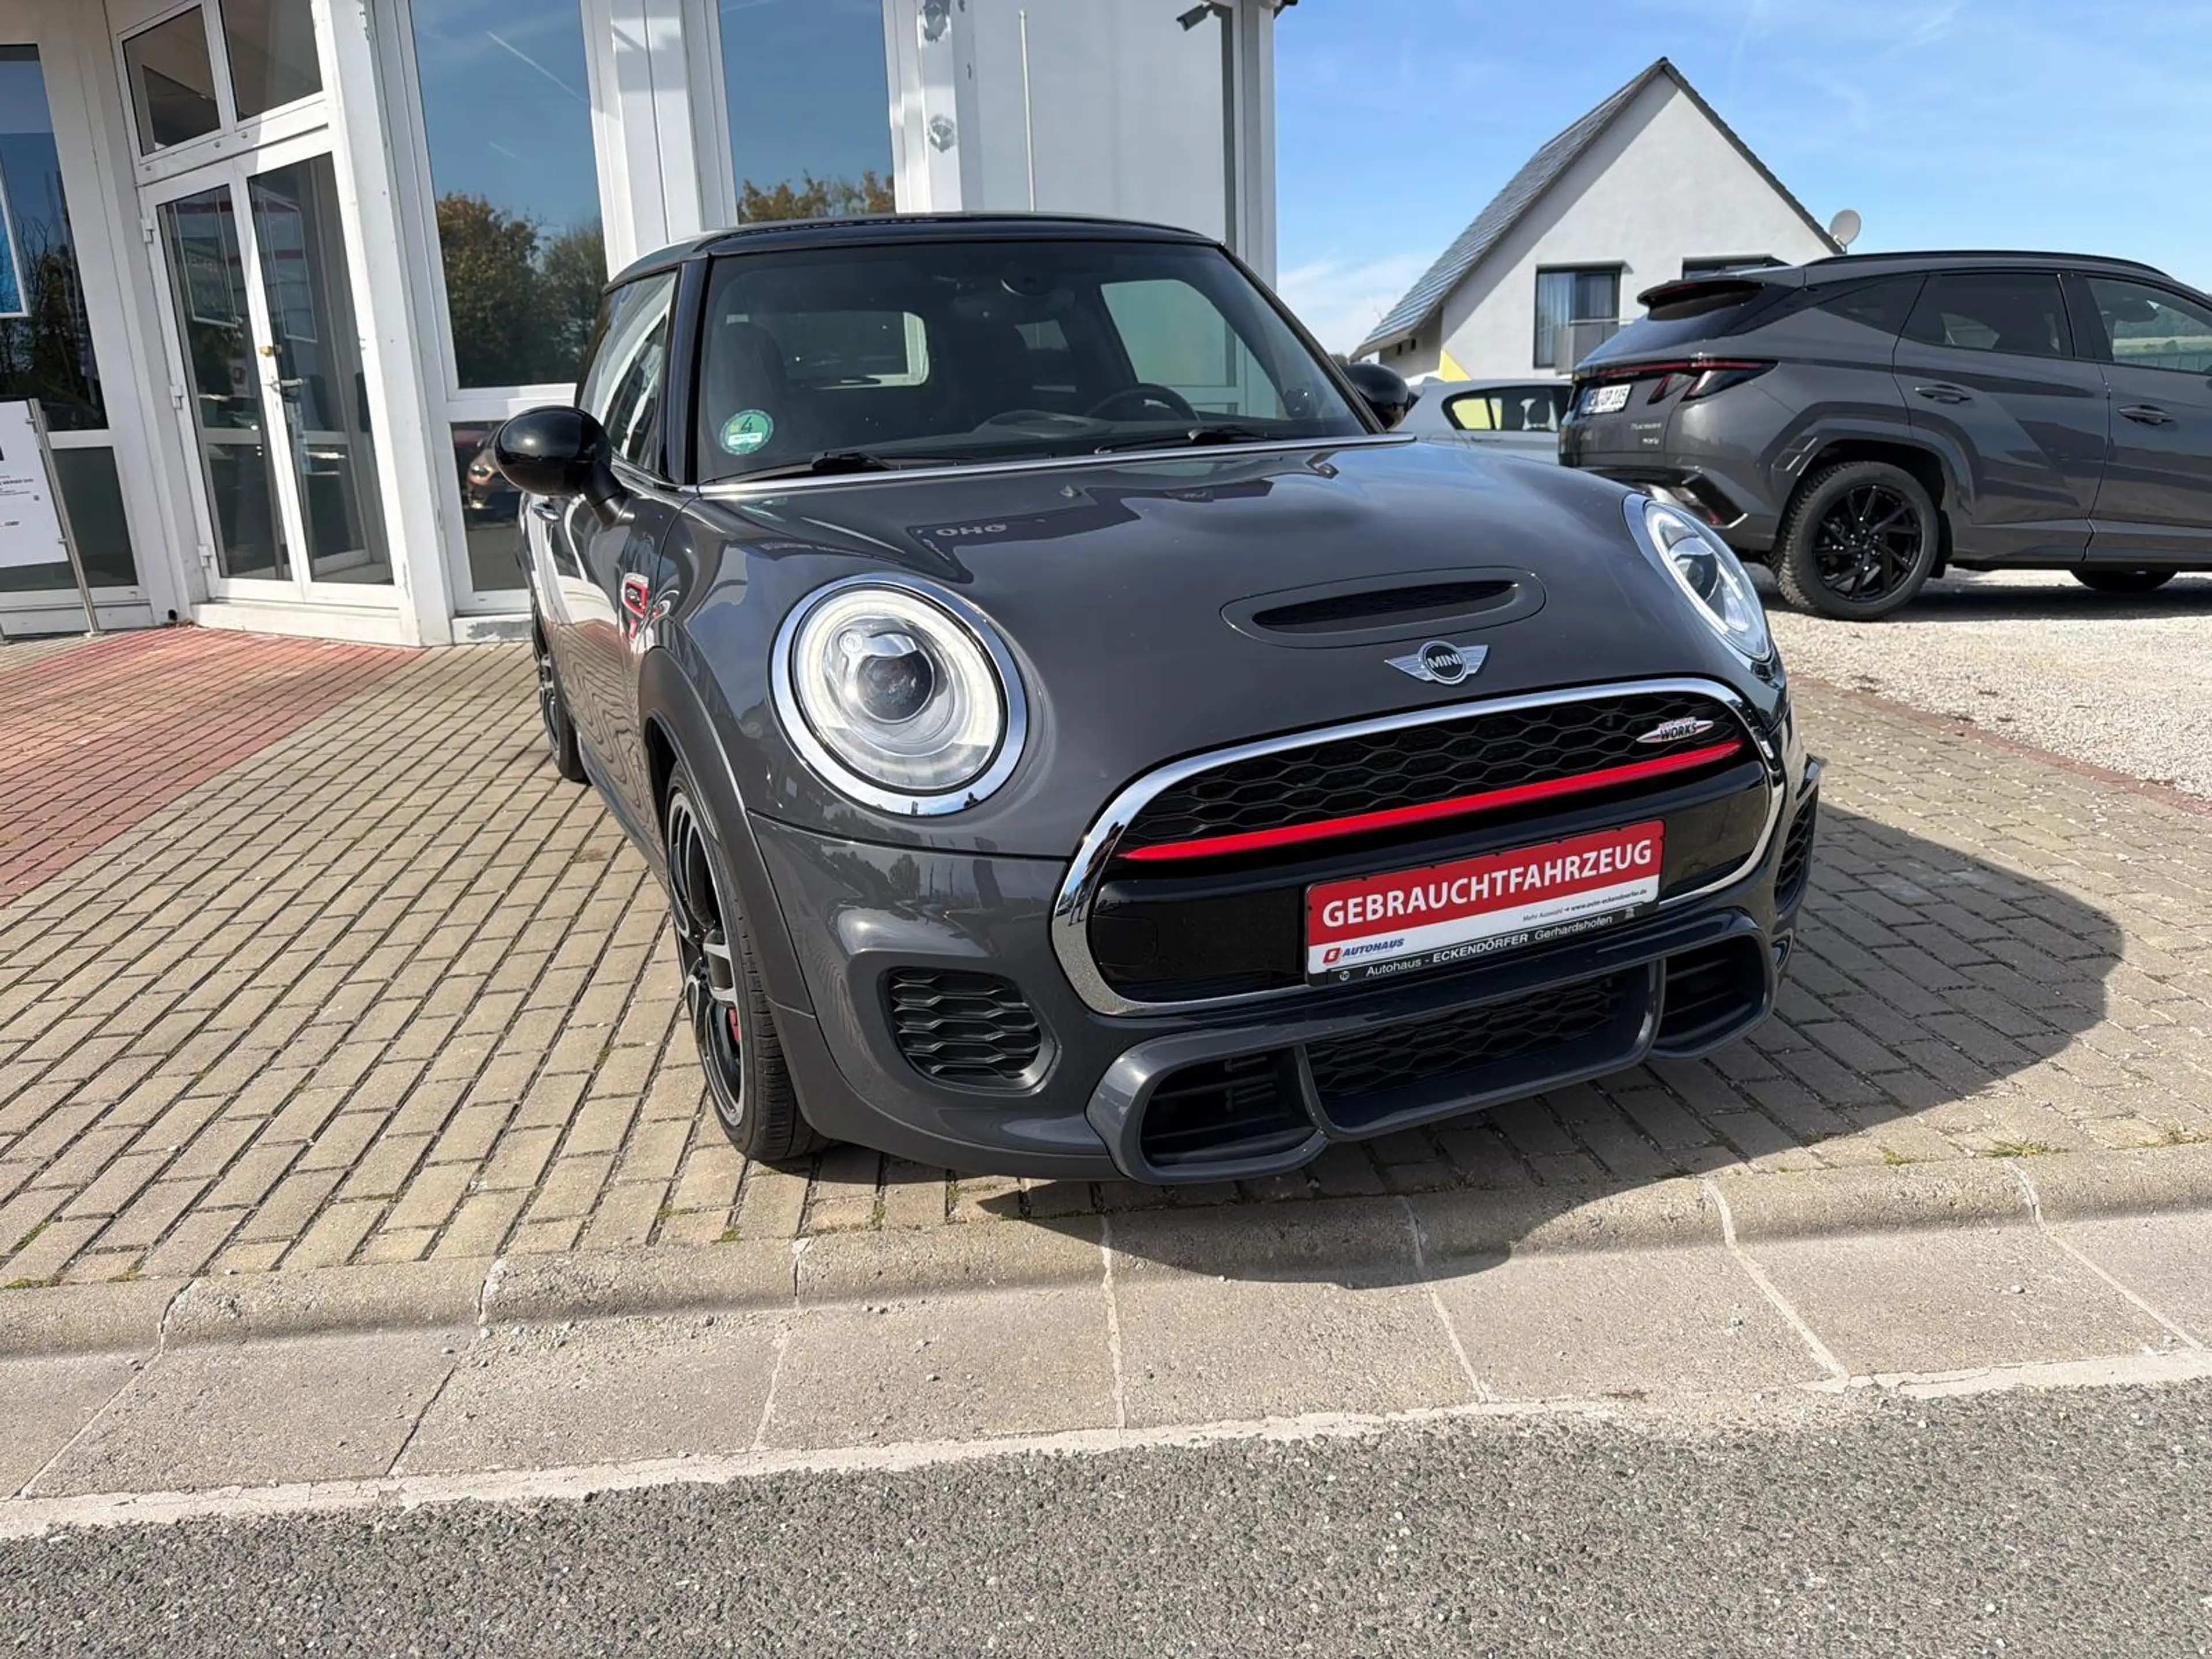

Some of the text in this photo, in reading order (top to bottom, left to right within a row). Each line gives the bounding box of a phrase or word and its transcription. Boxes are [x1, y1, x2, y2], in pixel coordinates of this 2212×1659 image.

[741, 416, 752, 432] 4
[1427, 654, 1462, 668] MINI
[1660, 723, 1697, 740] WORKS
[1323, 839, 1652, 928] GEBRAUCHTFAHRZEUG
[1343, 938, 1406, 957] AUTOHAUS
[1366, 958, 1422, 978] Autohaus
[1433, 933, 1528, 964] ECKENDÖRFER
[1535, 915, 1613, 941] Gerhardshofen
